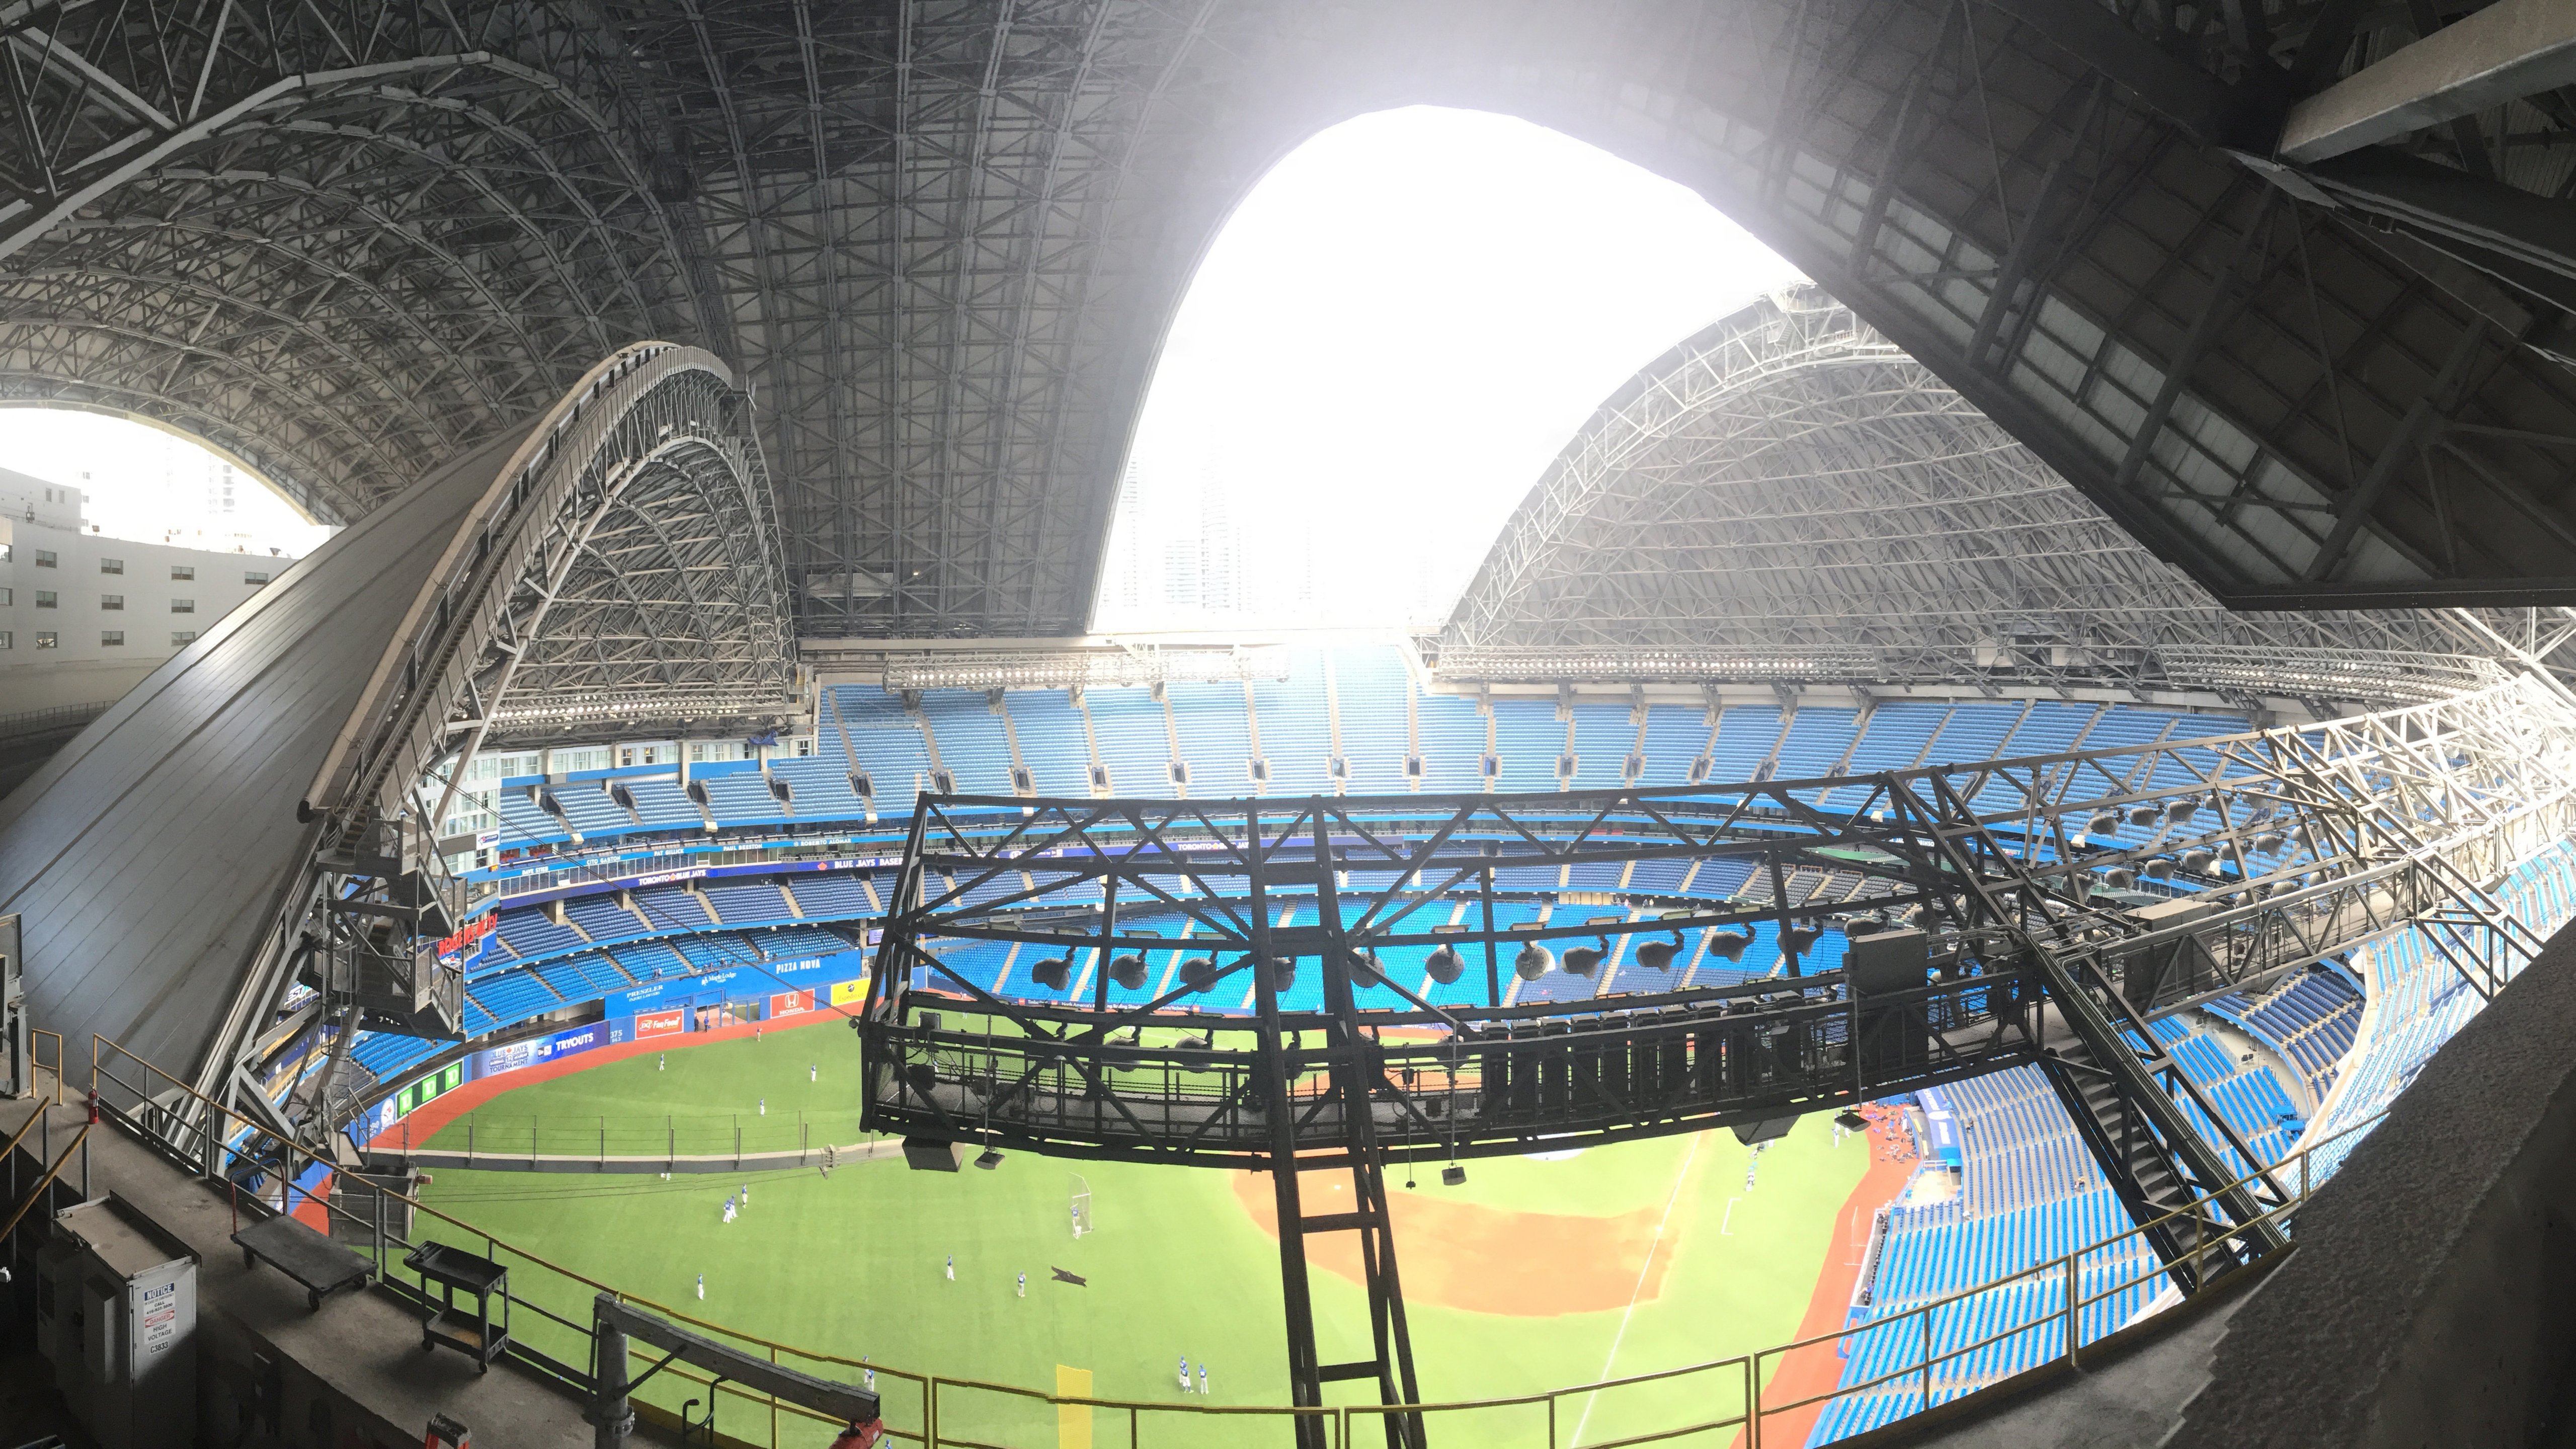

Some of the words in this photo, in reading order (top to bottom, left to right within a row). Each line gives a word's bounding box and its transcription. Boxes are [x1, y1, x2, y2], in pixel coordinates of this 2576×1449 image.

[600, 855, 621, 863] GASTON
[834, 860, 853, 868] BLUE
[856, 859, 875, 867] JAYS
[879, 857, 903, 866] BASEB
[638, 874, 670, 886] TORONTO
[676, 871, 690, 879] BLUE
[776, 962, 797, 974] PIZZA
[800, 958, 820, 970] NOVA
[626, 985, 663, 998] PRESZLER
[779, 1007, 805, 1015] HONDA
[610, 1029, 623, 1038] 375
[556, 1032, 594, 1051] TRYOUTS
[491, 1050, 506, 1059] BLUE
[513, 1045, 528, 1054] JAYS
[490, 1059, 528, 1073] TOURNAMENT
[447, 1069, 457, 1084] TD
[424, 1080, 435, 1095] TD
[401, 1093, 412, 1109] TD
[147, 1284, 172, 1300] NOTICE
[150, 1314, 171, 1325] DANGER
[153, 1323, 167, 1332] HIGH
[148, 1328, 173, 1341] VOLTAGE
[150, 1341, 169, 1353] C3833
